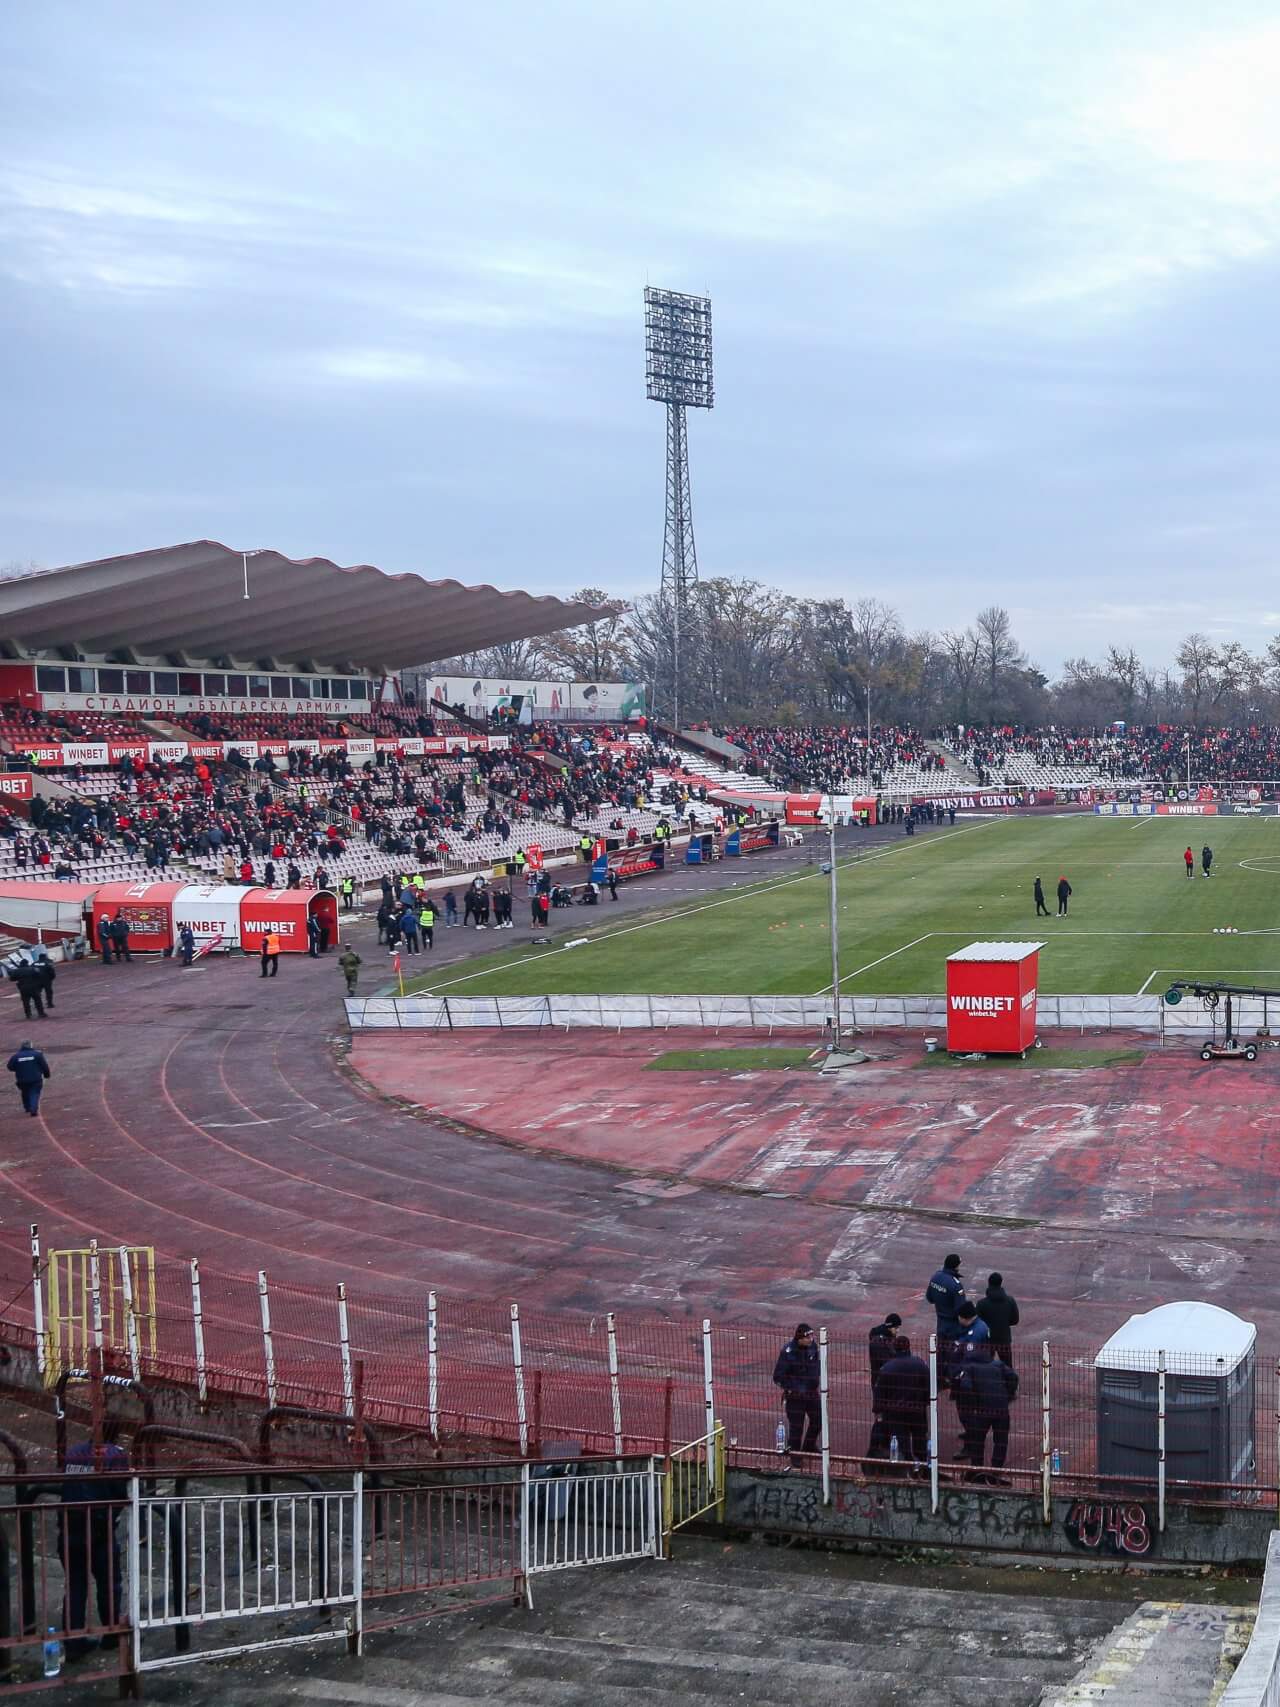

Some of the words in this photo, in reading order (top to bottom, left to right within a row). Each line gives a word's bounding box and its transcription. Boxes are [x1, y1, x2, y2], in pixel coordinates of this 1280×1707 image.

[85, 699, 176, 711] СТАДИОН
[199, 700, 288, 712] БЪЛГАРСКА
[297, 702, 341, 712] АРМИЯ
[68, 749, 104, 759] WINBET
[190, 746, 220, 756] WINBET
[980, 793, 1022, 807] СЕКТО
[1168, 805, 1205, 814] WINBET
[244, 920, 296, 933] WINBET
[951, 995, 1015, 1011] WINBET
[968, 1010, 998, 1018] winbet.bg
